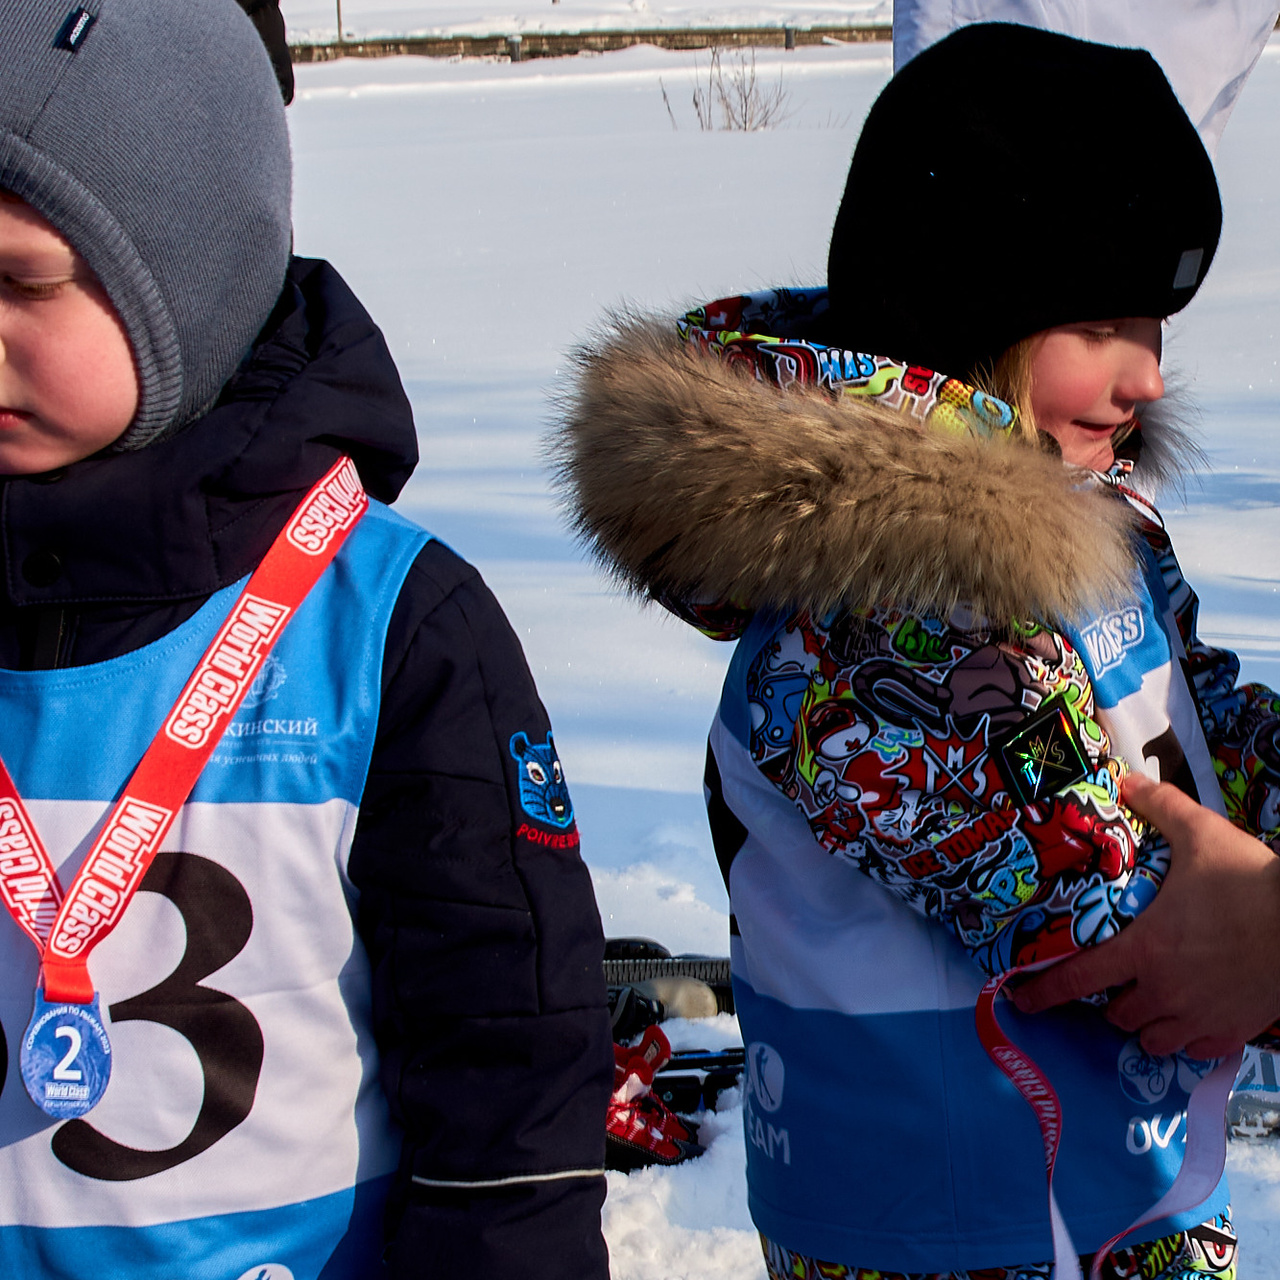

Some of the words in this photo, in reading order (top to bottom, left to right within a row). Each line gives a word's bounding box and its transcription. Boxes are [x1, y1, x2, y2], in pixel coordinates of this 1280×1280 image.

[293, 492, 349, 550] Class
[210, 601, 284, 682] World
[172, 671, 237, 744] Class
[225, 717, 318, 737] КИНСКИЙ
[91, 803, 164, 892] World
[54, 875, 120, 953] Class
[0, 851, 264, 1181] 3
[53, 1025, 82, 1081] 2
[47, 1084, 68, 1097] World
[68, 1085, 89, 1098] Class
